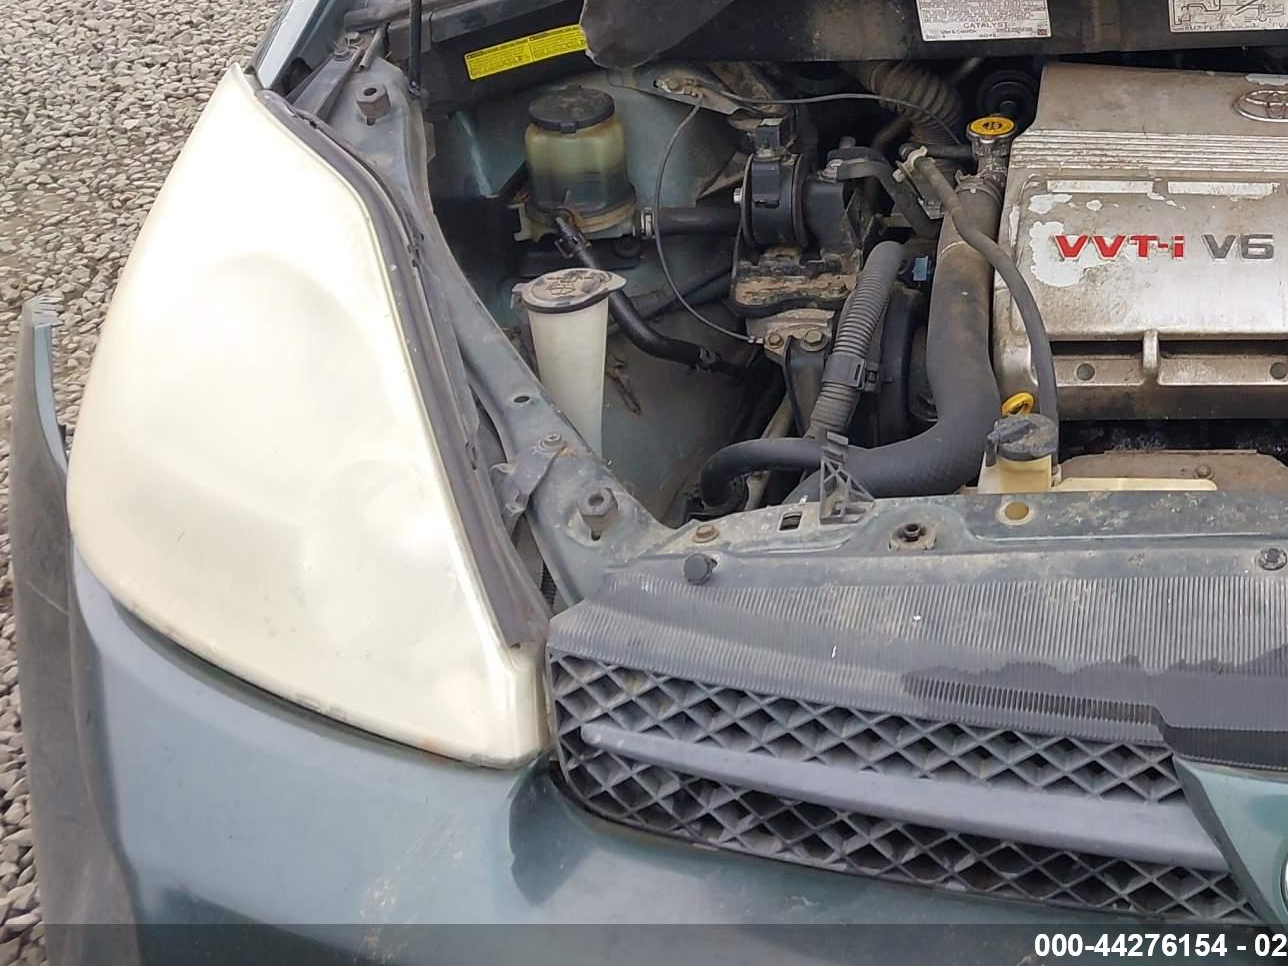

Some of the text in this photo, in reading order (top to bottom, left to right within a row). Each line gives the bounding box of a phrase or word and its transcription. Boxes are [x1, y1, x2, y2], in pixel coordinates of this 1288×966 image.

[963, 21, 1009, 29] CATALYST
[1053, 234, 1185, 259] VVT-i
[1202, 234, 1274, 261] V6
